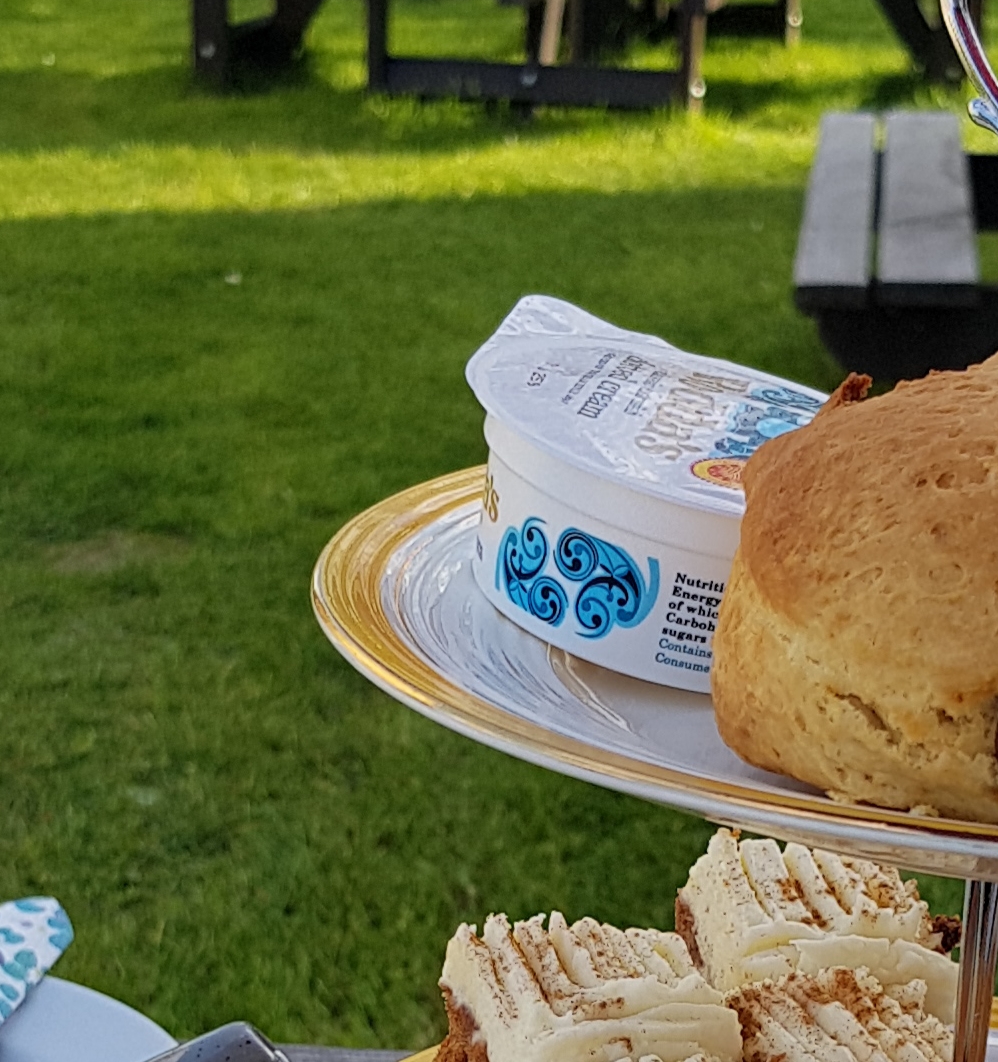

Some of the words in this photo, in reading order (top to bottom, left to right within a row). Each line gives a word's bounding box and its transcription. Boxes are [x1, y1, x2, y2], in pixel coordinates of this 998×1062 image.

[577, 380, 621, 418] cream
[672, 585, 721, 607] Energy
[668, 601, 684, 612] of
[686, 605, 720, 619] whic
[666, 612, 715, 632] Carboh
[661, 627, 707, 643] sugars
[659, 638, 713, 659] Contains
[654, 652, 711, 673] Consume
